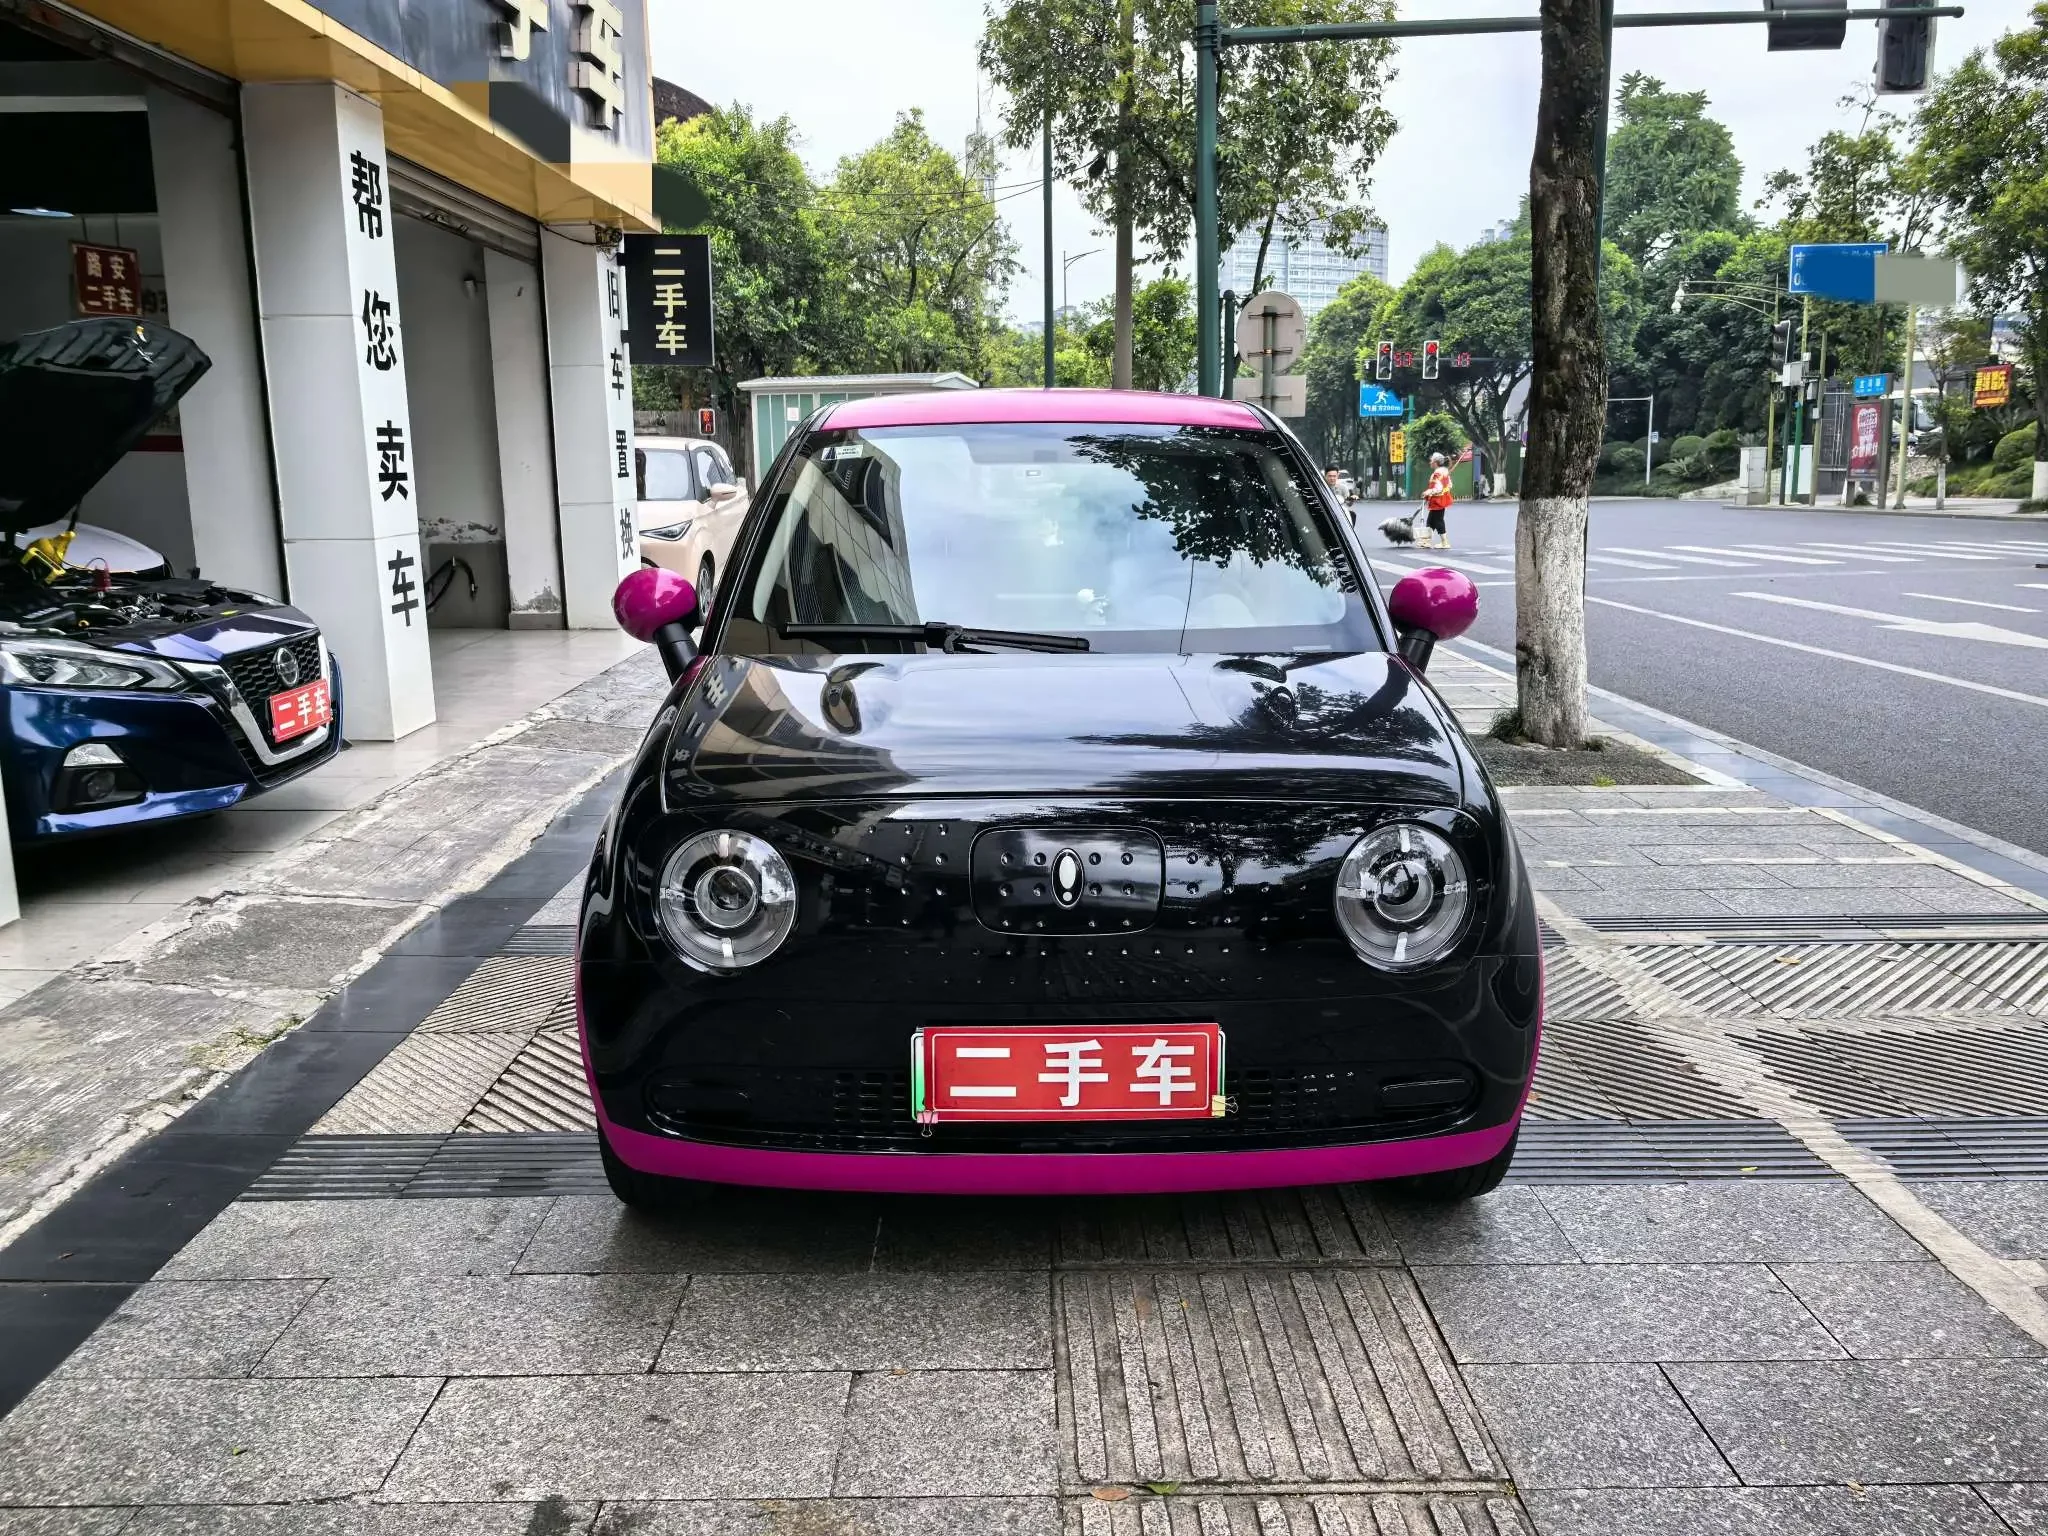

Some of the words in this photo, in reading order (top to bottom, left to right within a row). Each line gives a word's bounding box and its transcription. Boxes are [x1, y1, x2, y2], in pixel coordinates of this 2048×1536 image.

[87, 285, 134, 311] 二手车
[653, 249, 688, 356] 二手车
[350, 149, 419, 627] 帮您卖车
[607, 269, 634, 559] 旧车置换
[278, 688, 328, 730] 二手车
[950, 1039, 1196, 1107] 二手车
